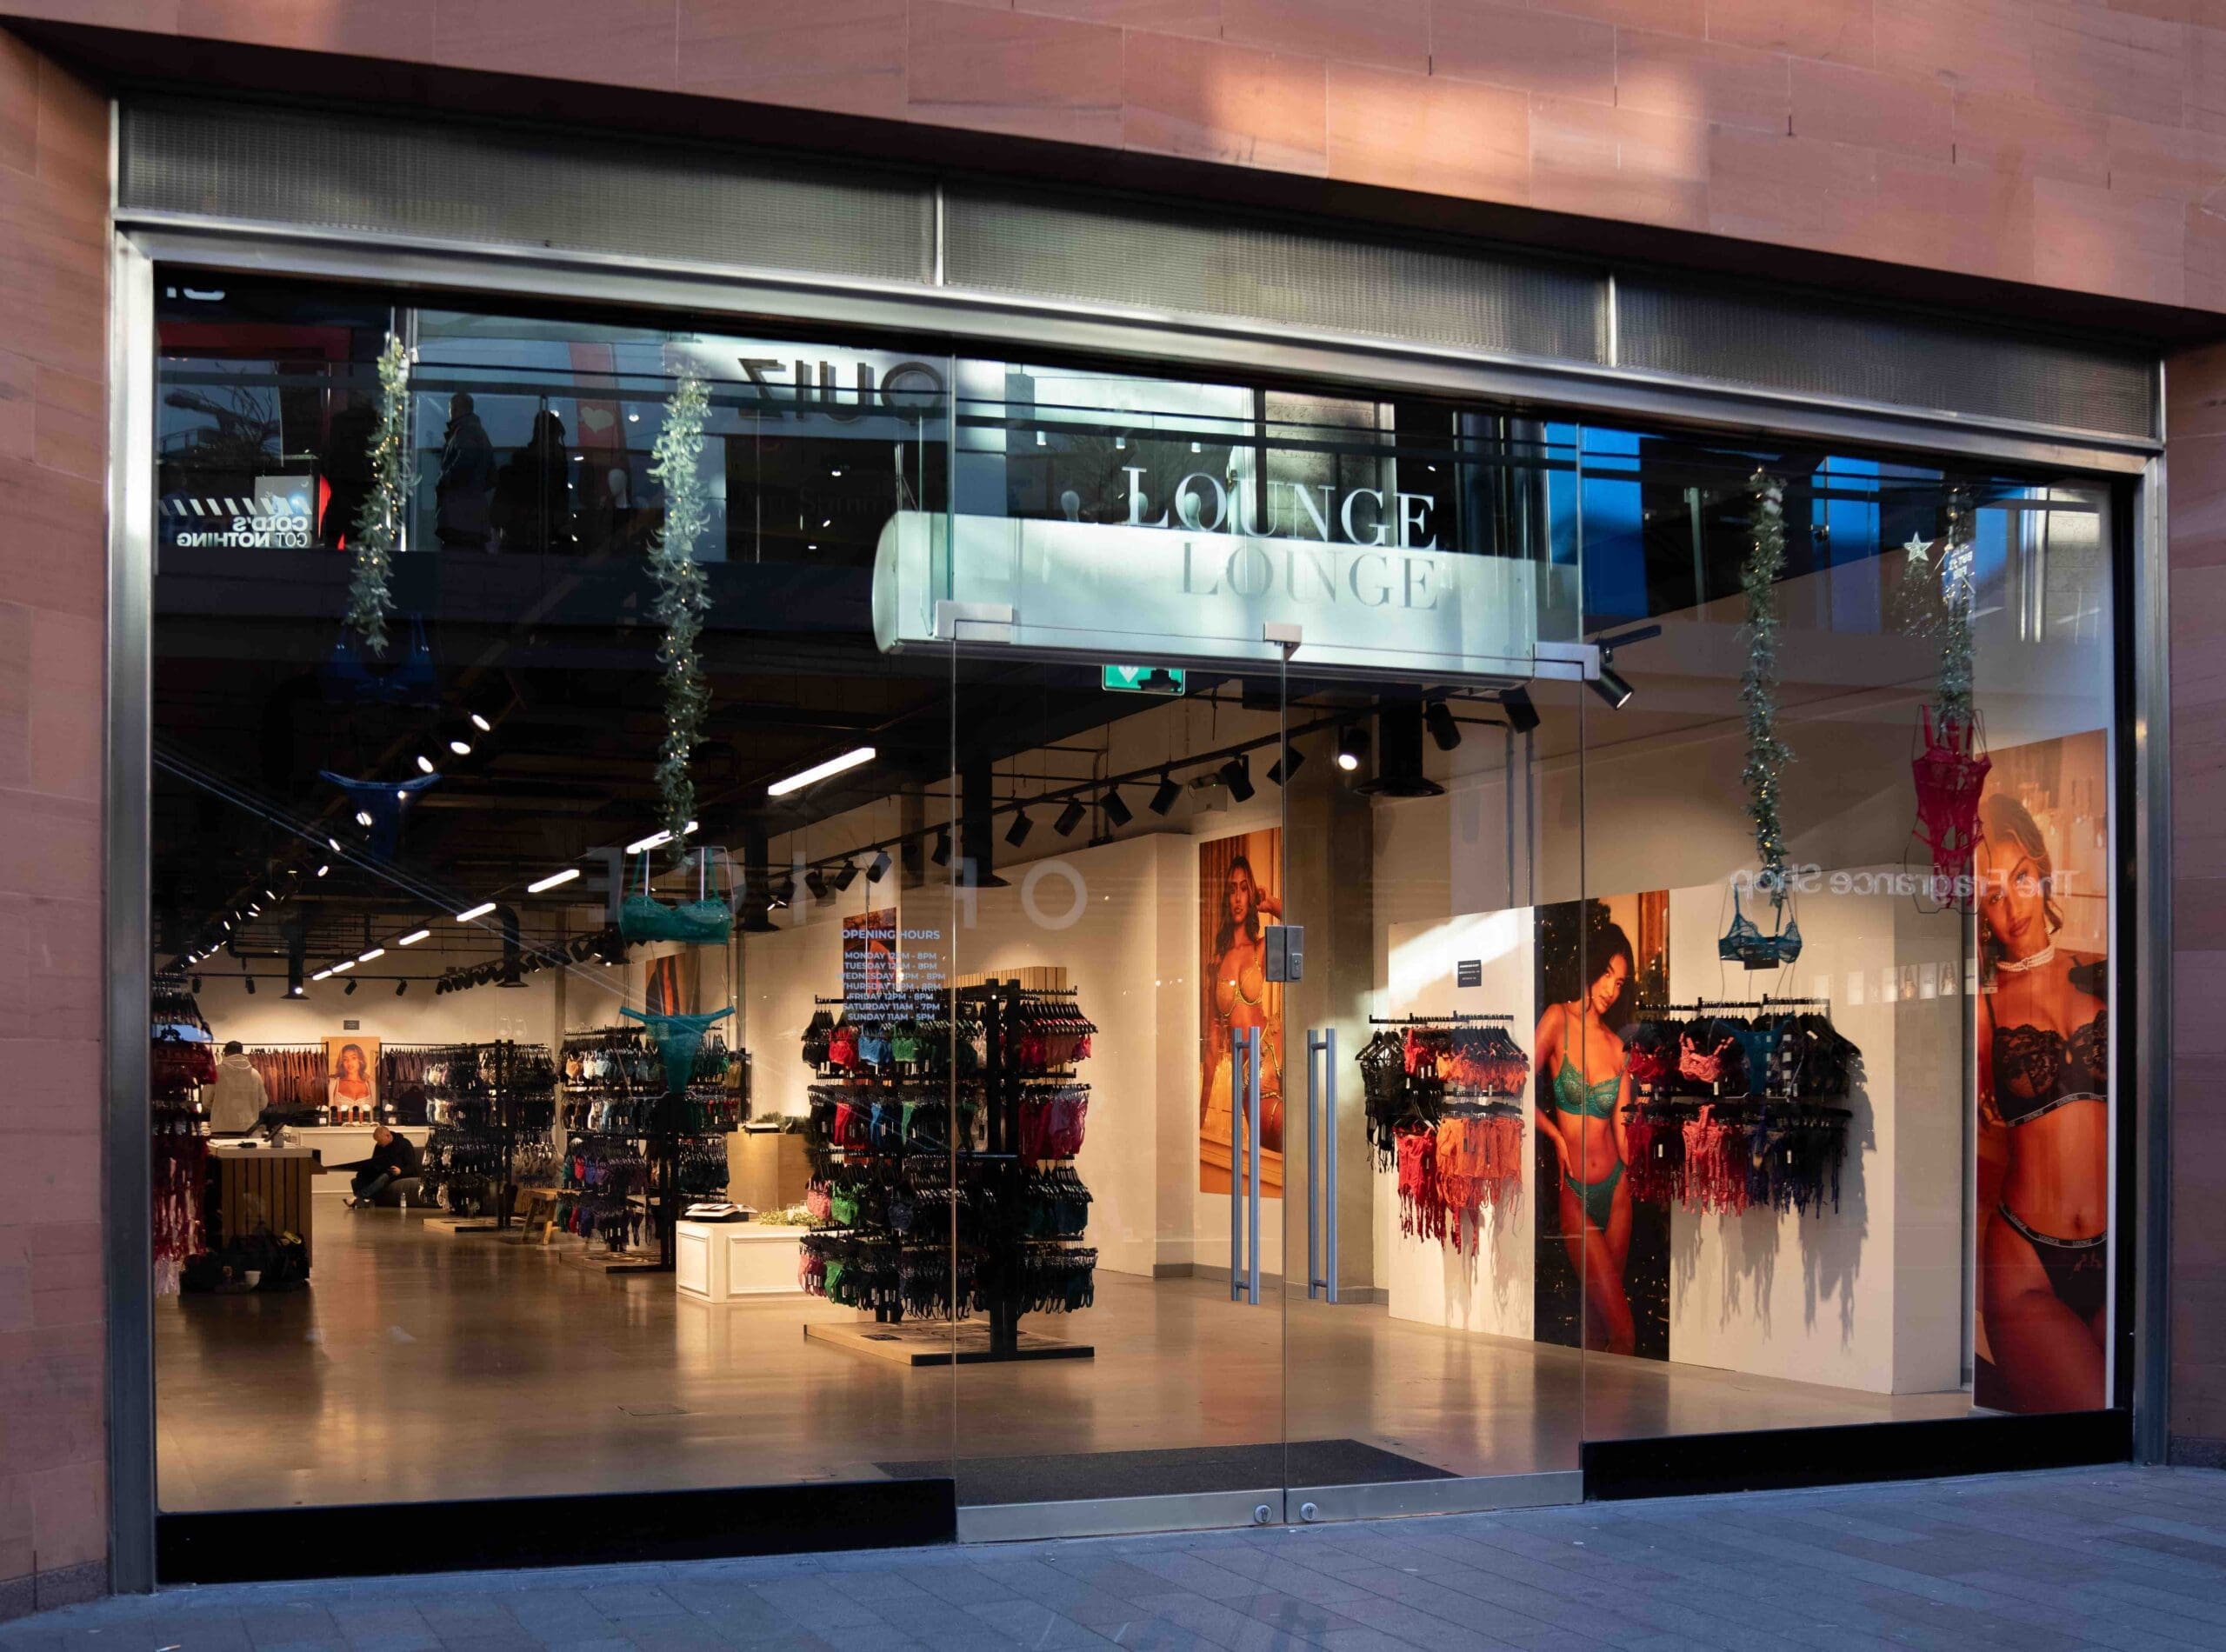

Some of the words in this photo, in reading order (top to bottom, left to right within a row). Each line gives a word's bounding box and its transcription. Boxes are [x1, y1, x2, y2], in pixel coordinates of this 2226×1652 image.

[1121, 466, 1437, 551] LOUNGE
[1176, 541, 1439, 610] LOUNGE
[842, 929, 896, 940] OPENING
[899, 929, 941, 940] HOURS
